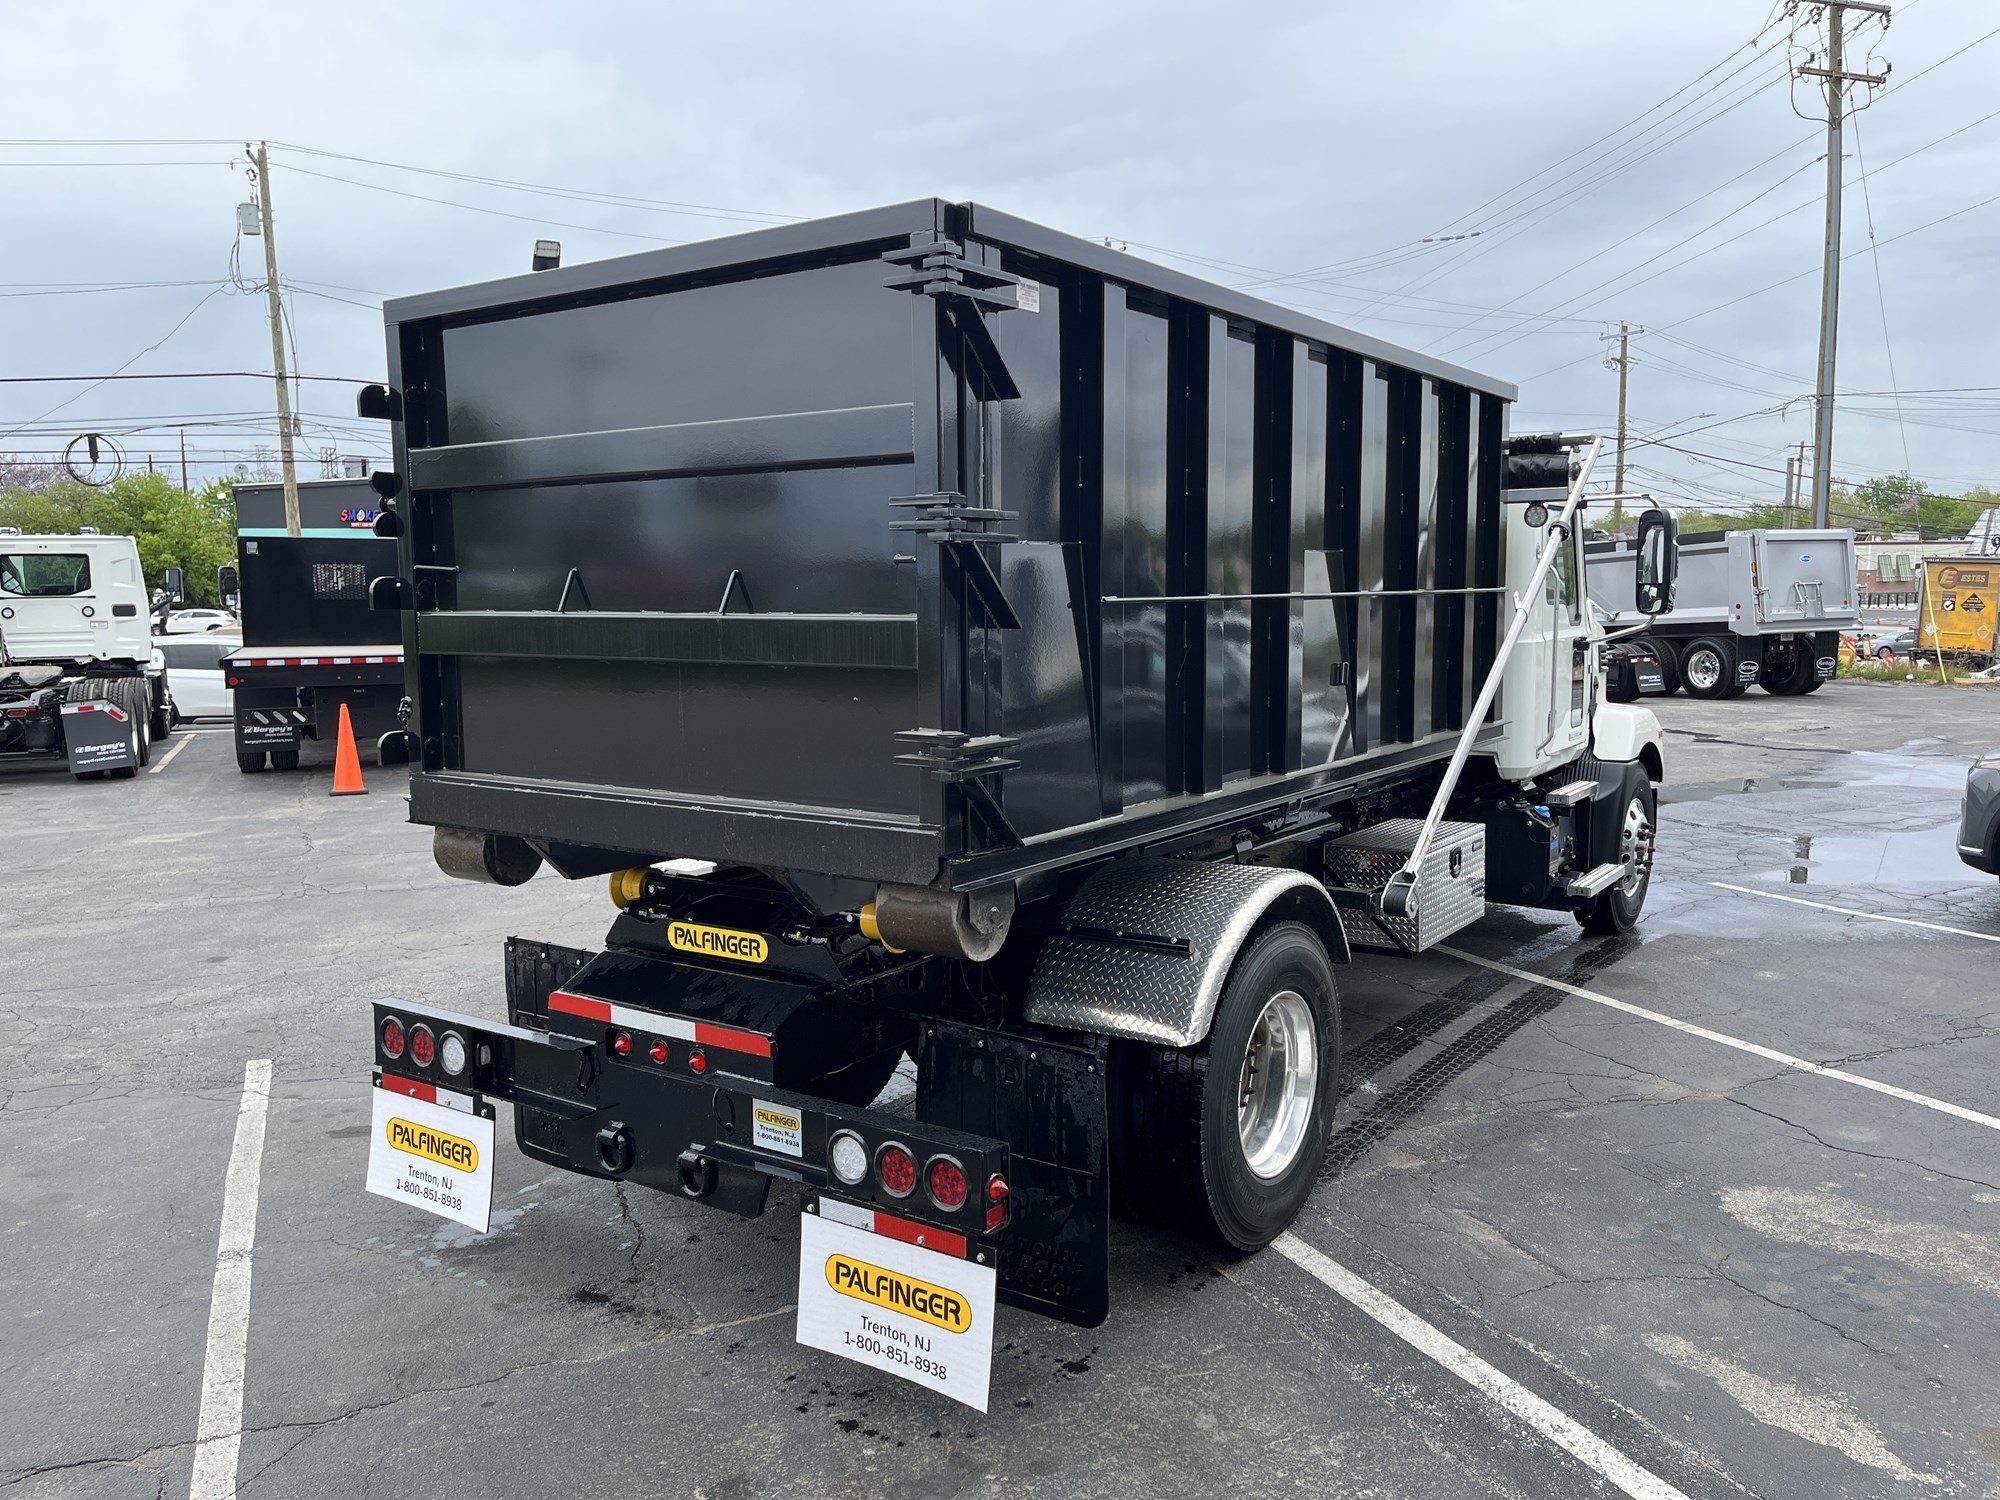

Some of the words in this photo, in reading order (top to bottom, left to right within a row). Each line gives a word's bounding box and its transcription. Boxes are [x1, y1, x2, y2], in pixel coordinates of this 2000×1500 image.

[1961, 574, 1986, 583] ESTES
[253, 725, 293, 733] Bergey's
[84, 742, 126, 753] Bergey's
[674, 926, 761, 958] PALFINGER
[757, 1111, 797, 1129] PALFINGER
[760, 1124, 783, 1136] Trenton,
[785, 1131, 796, 1139] N.J.
[393, 1123, 472, 1167] PALFINGER
[757, 1132, 800, 1148] 1-800-851-8938
[408, 1165, 440, 1188] Trenton,
[441, 1176, 453, 1190] NJ
[396, 1178, 462, 1211] 1-800-851-8938
[835, 1261, 961, 1326] PALFINGER
[860, 1315, 910, 1348] Trenton,
[914, 1334, 931, 1353] NJ
[844, 1331, 947, 1381] 1-800-851-8938
